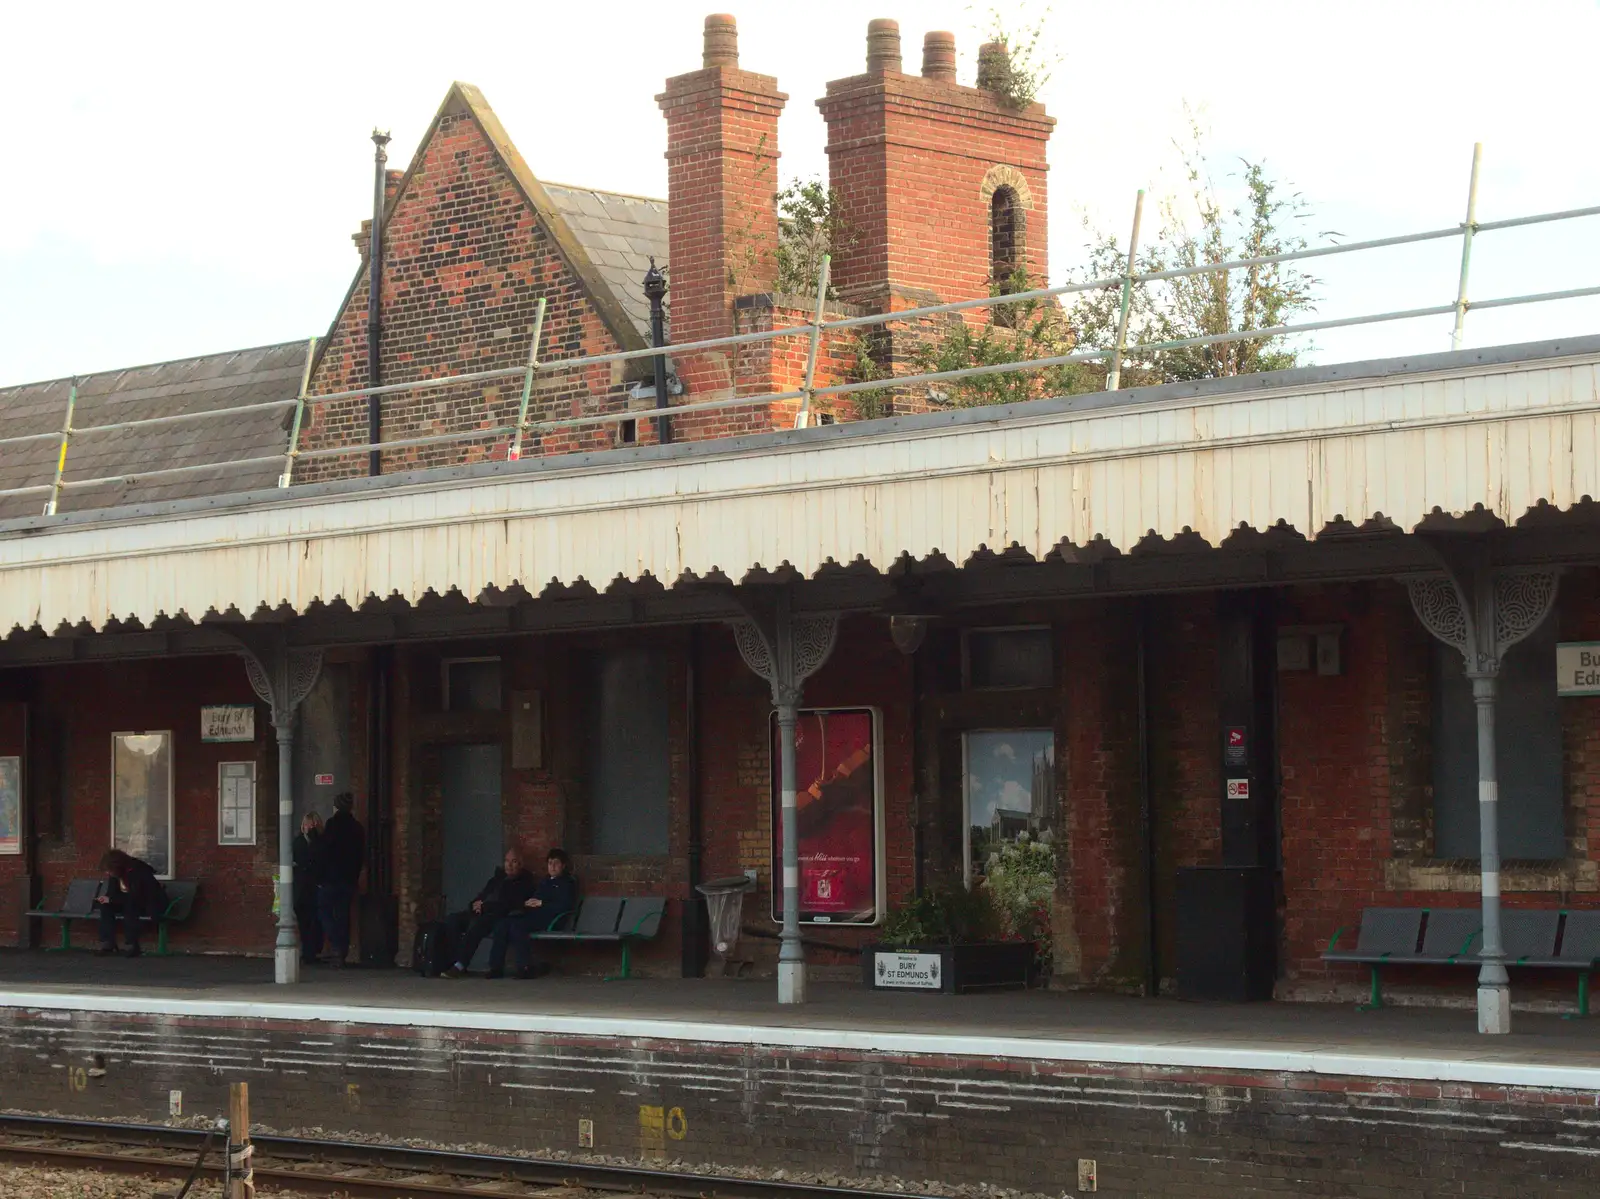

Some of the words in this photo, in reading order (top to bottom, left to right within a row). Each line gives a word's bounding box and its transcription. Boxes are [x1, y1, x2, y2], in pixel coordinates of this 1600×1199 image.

[899, 962, 917, 970] BURY
[887, 970, 895, 978] ST
[897, 971, 929, 979] EDMUNDS
